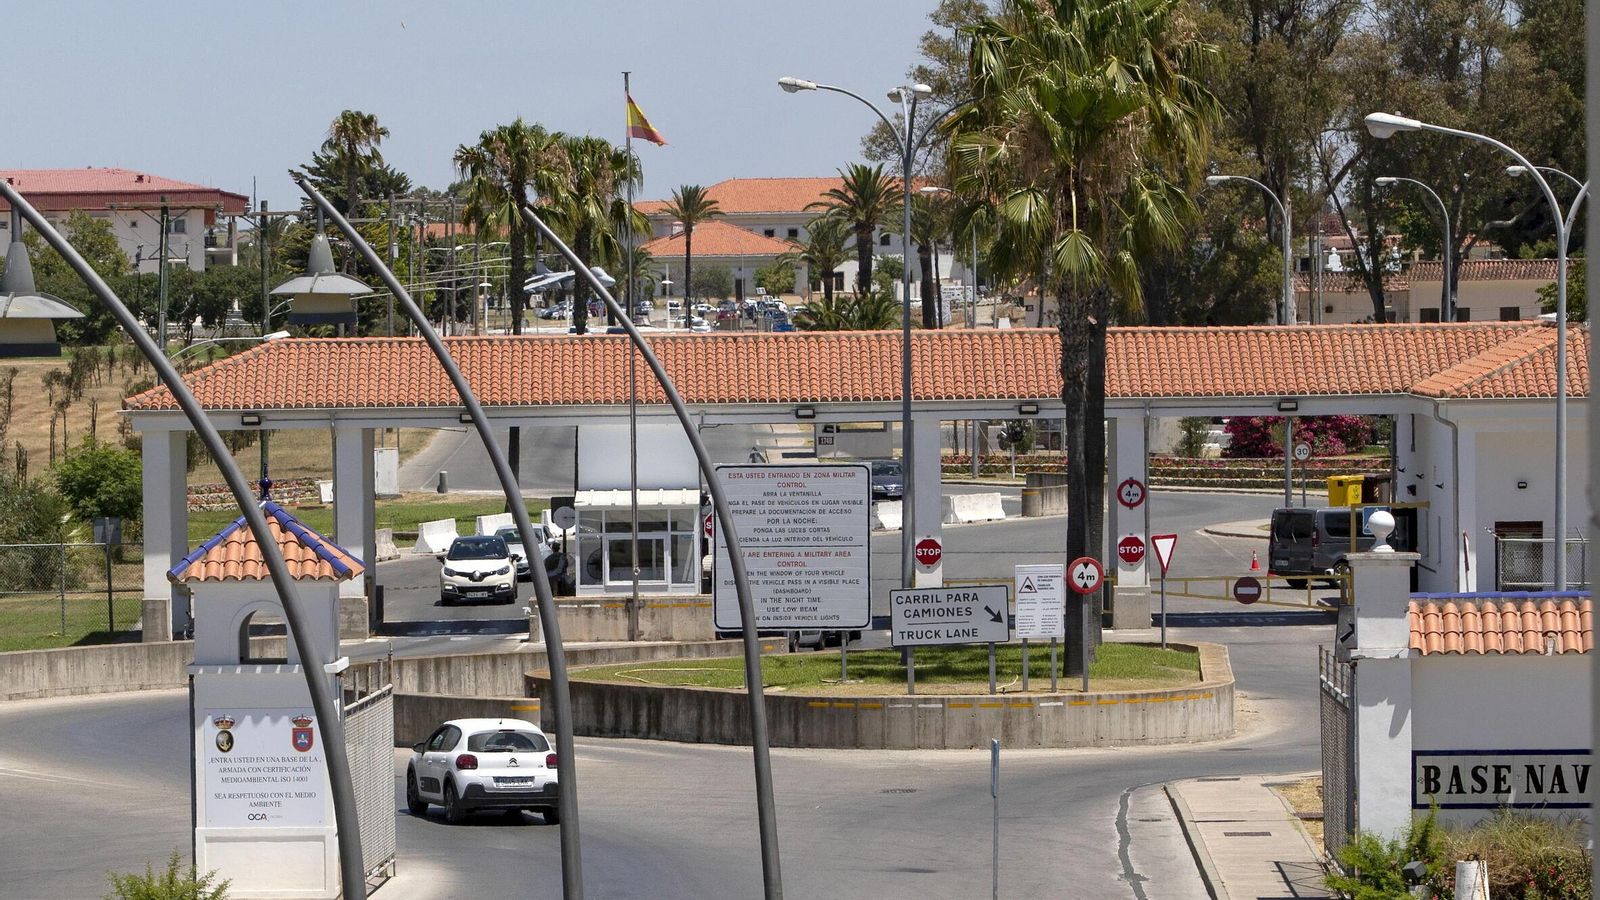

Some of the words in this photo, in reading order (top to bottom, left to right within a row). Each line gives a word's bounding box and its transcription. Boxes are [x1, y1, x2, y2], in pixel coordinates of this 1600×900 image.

[896, 594, 942, 605] CARRIL
[946, 593, 979, 603] PARA
[904, 607, 973, 618] CAMIONES
[900, 629, 942, 640] TRUCK
[947, 628, 979, 638] LANE
[1422, 765, 1512, 794] BASE
